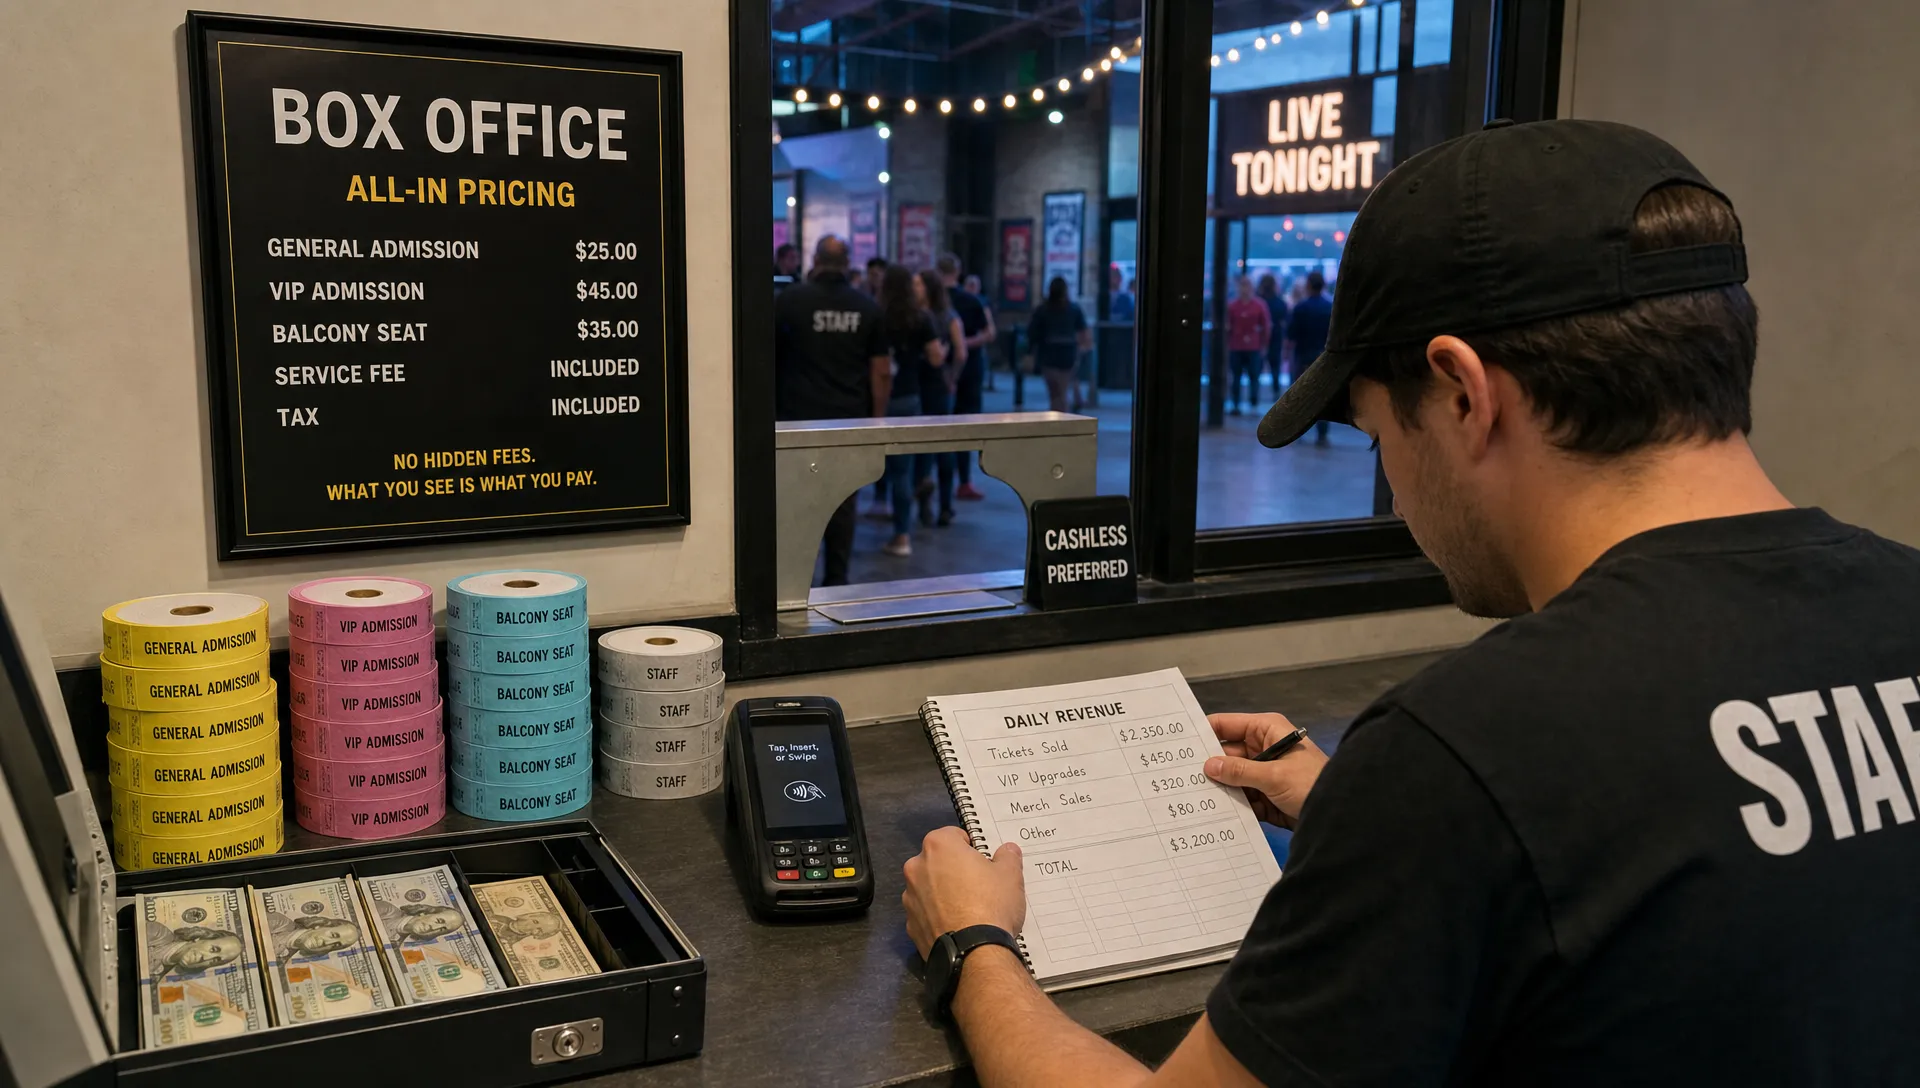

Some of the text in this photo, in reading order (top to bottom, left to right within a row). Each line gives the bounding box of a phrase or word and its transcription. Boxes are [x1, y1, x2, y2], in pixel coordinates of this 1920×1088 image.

[272, 87, 628, 161] BOX OFFICE
[1267, 91, 1344, 144] LIVE
[1231, 140, 1381, 196] TONIGHT
[346, 174, 575, 207] ALL-IN PRICING
[267, 237, 638, 263] GENERAL ADMISSION $25.00
[269, 279, 638, 302] VIP ADMISSION $45.00
[272, 318, 640, 344] BALCONY SEAT $35.00
[812, 309, 862, 334] STAFF
[275, 358, 640, 386] SERVICE FEE INCLUDED
[276, 395, 641, 427] TAX INCLUDED
[393, 447, 537, 471] NO HIDDEN FEES.
[326, 470, 598, 501] WHAT YOU SEE IS WHAT YOU PAY.
[1045, 524, 1128, 552] CASHLESS
[1047, 559, 1129, 584] PREFERRED
[340, 614, 418, 634] VIP ADMISSION
[496, 605, 575, 625] BALCONY SEAT
[144, 629, 257, 655] GENERAL ADMISSION
[497, 644, 575, 664] BALCONY SEAT
[341, 652, 420, 673] VIP ADMISSION
[647, 667, 679, 680] STAFF
[149, 671, 260, 698] GENERAL ADMISSION
[497, 680, 575, 700] BALCONY SEAT
[341, 690, 421, 711] VIP ADMISSION
[659, 703, 690, 718] STAFF
[153, 712, 264, 740] GENERAL ADMISSION
[498, 717, 576, 738] BALCONY SEAT
[1003, 701, 1126, 730] DAILY REVENUE
[344, 728, 424, 749] VIP ADMISSION
[655, 740, 687, 753] STAFF
[768, 743, 819, 753] Tap, Insert,
[987, 721, 1185, 761] Tickets Sold $2,350.00
[154, 753, 265, 783] GENERAL ADMISSION
[499, 752, 577, 774] BALCONY SEAT
[788, 752, 817, 763] Swipe
[997, 746, 1195, 788] VIP Upgrades $450.00
[1709, 675, 1920, 856] STAF
[348, 766, 427, 788] VIP ADMISSION
[656, 775, 687, 788] STAFF
[499, 788, 578, 811] BALCONY SEAT
[1009, 772, 1206, 815] Merch Sales $320.00
[152, 794, 265, 824] GENERAL ADMISSION
[351, 803, 430, 826] VIP ADMISSION
[1019, 798, 1217, 842] Other $80.00
[152, 835, 265, 865] GENERAL ADMISSION
[1034, 828, 1236, 877] TOTAL $3,200.00
